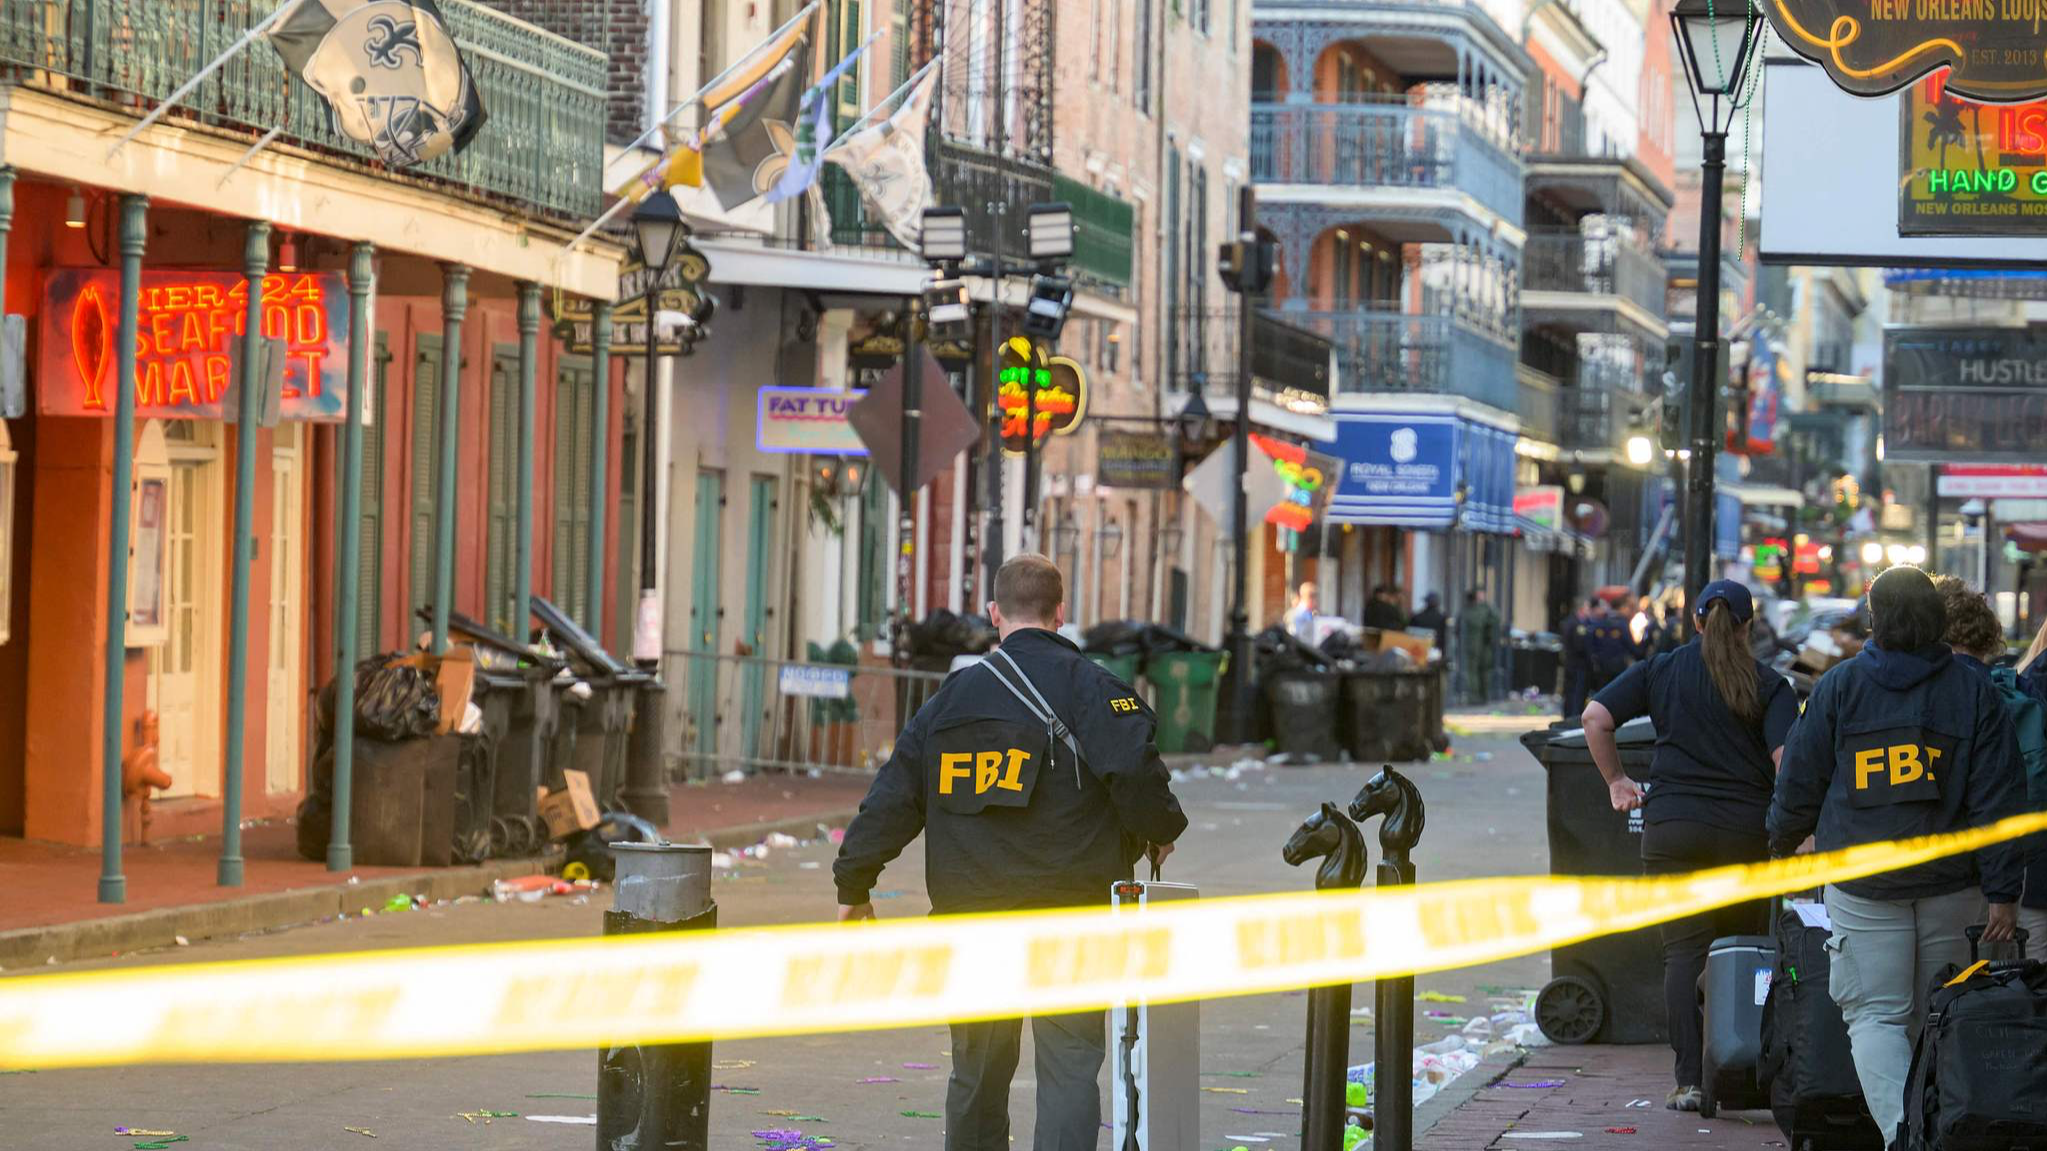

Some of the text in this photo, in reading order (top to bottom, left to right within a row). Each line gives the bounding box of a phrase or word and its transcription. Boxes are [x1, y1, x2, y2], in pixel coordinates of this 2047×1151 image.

[1872, 0, 1910, 20] NEW
[1916, 0, 1996, 21] ORLEANS
[1972, 50, 2037, 64] EST. 2013
[1930, 168, 2017, 192] HAND
[1916, 202, 1948, 215] NEW
[1952, 202, 2016, 215] ORLEANS
[137, 284, 226, 312] IER
[768, 396, 809, 413] FAT
[1110, 697, 1139, 712] FBI
[939, 747, 1031, 794] FBI
